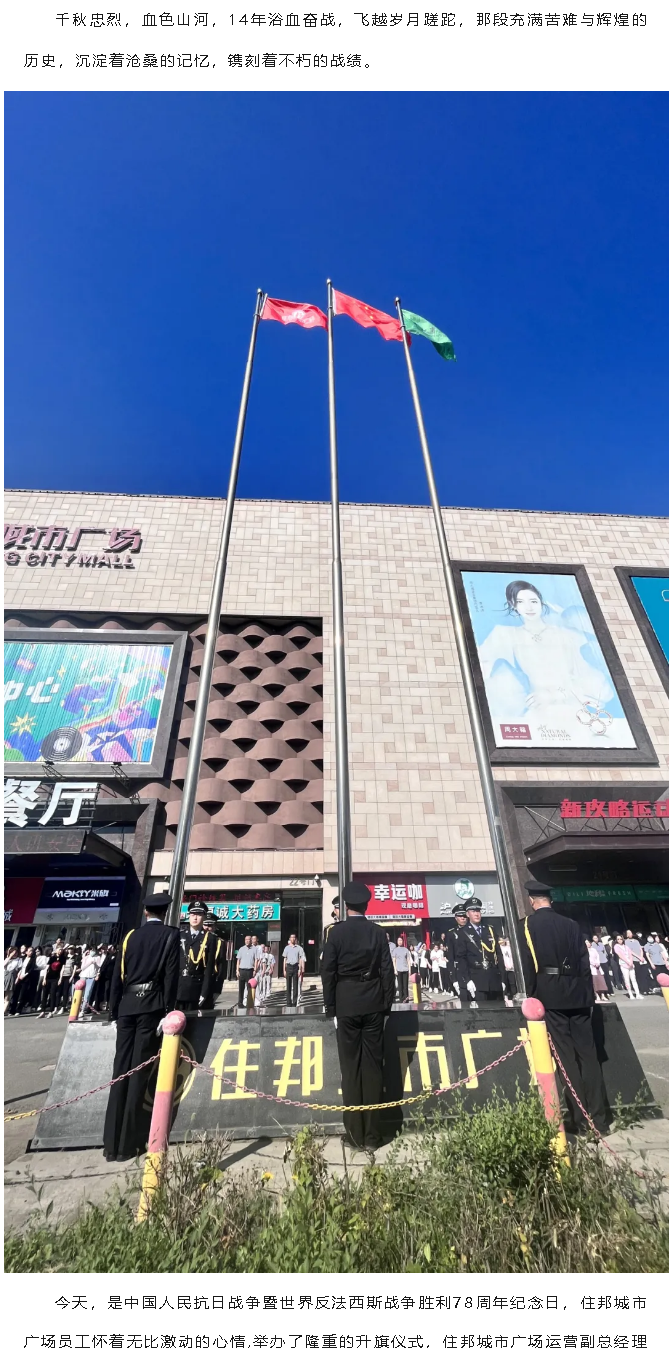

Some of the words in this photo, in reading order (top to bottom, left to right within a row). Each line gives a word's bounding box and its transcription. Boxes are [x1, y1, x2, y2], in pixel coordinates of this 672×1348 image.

[26, 551, 77, 567] CITY
[78, 553, 135, 569] MALL
[4, 778, 98, 828] 餐厅
[374, 883, 424, 901] 幸运咖
